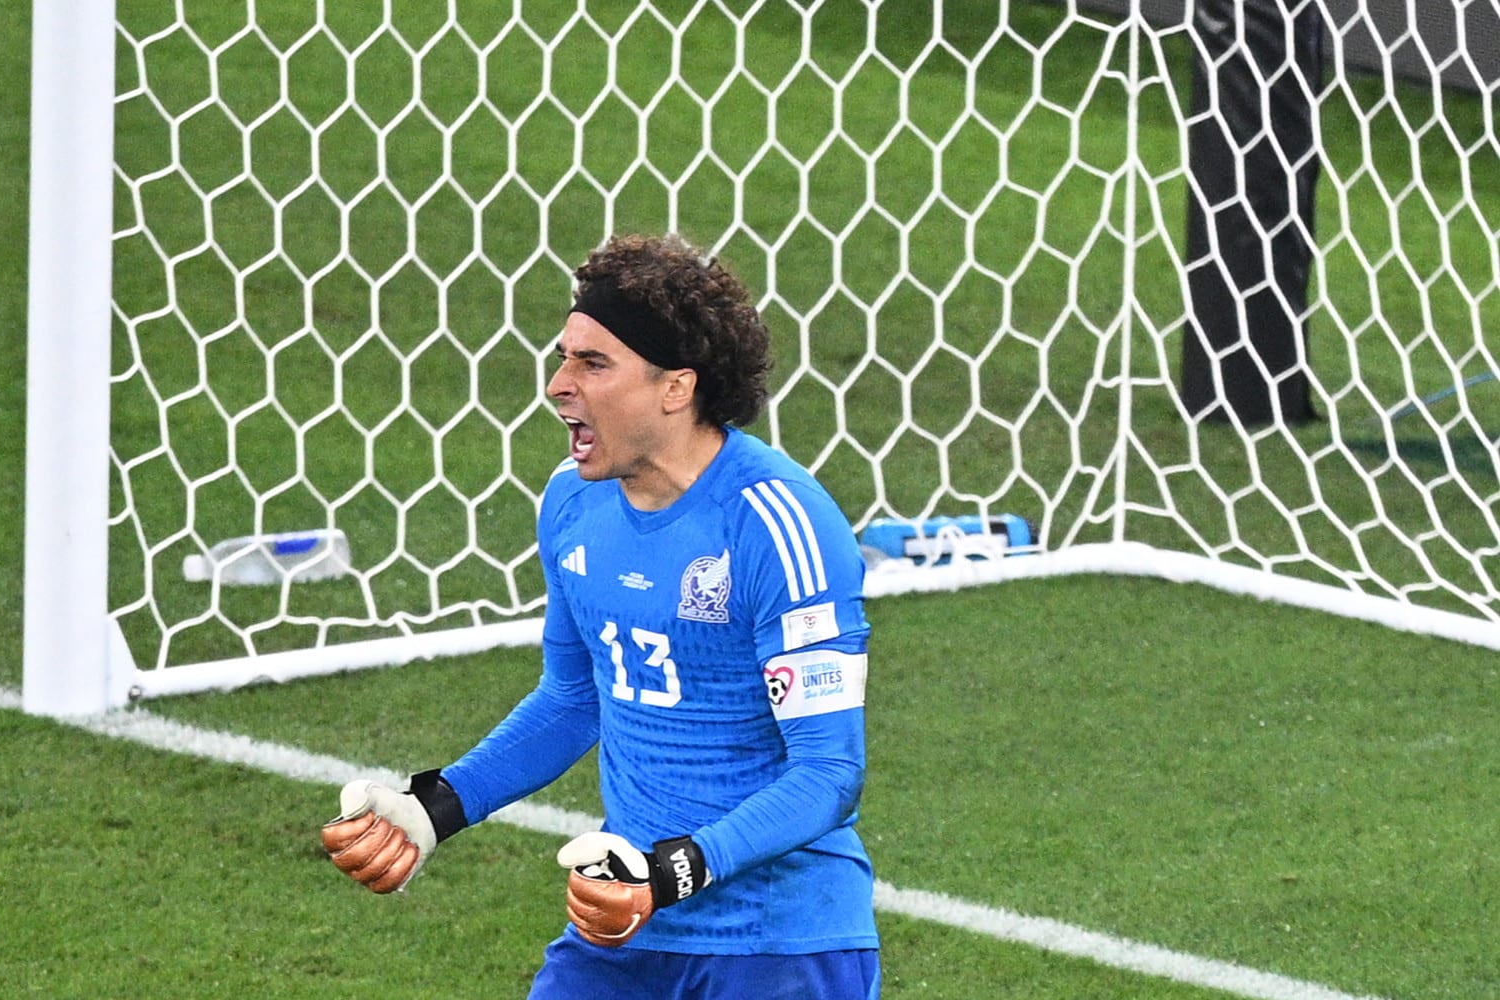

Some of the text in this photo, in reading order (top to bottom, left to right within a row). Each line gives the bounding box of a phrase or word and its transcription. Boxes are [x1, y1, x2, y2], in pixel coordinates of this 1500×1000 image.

[599, 621, 682, 708] 13
[802, 670, 843, 688] UNITES
[669, 848, 694, 900] OCHOA
